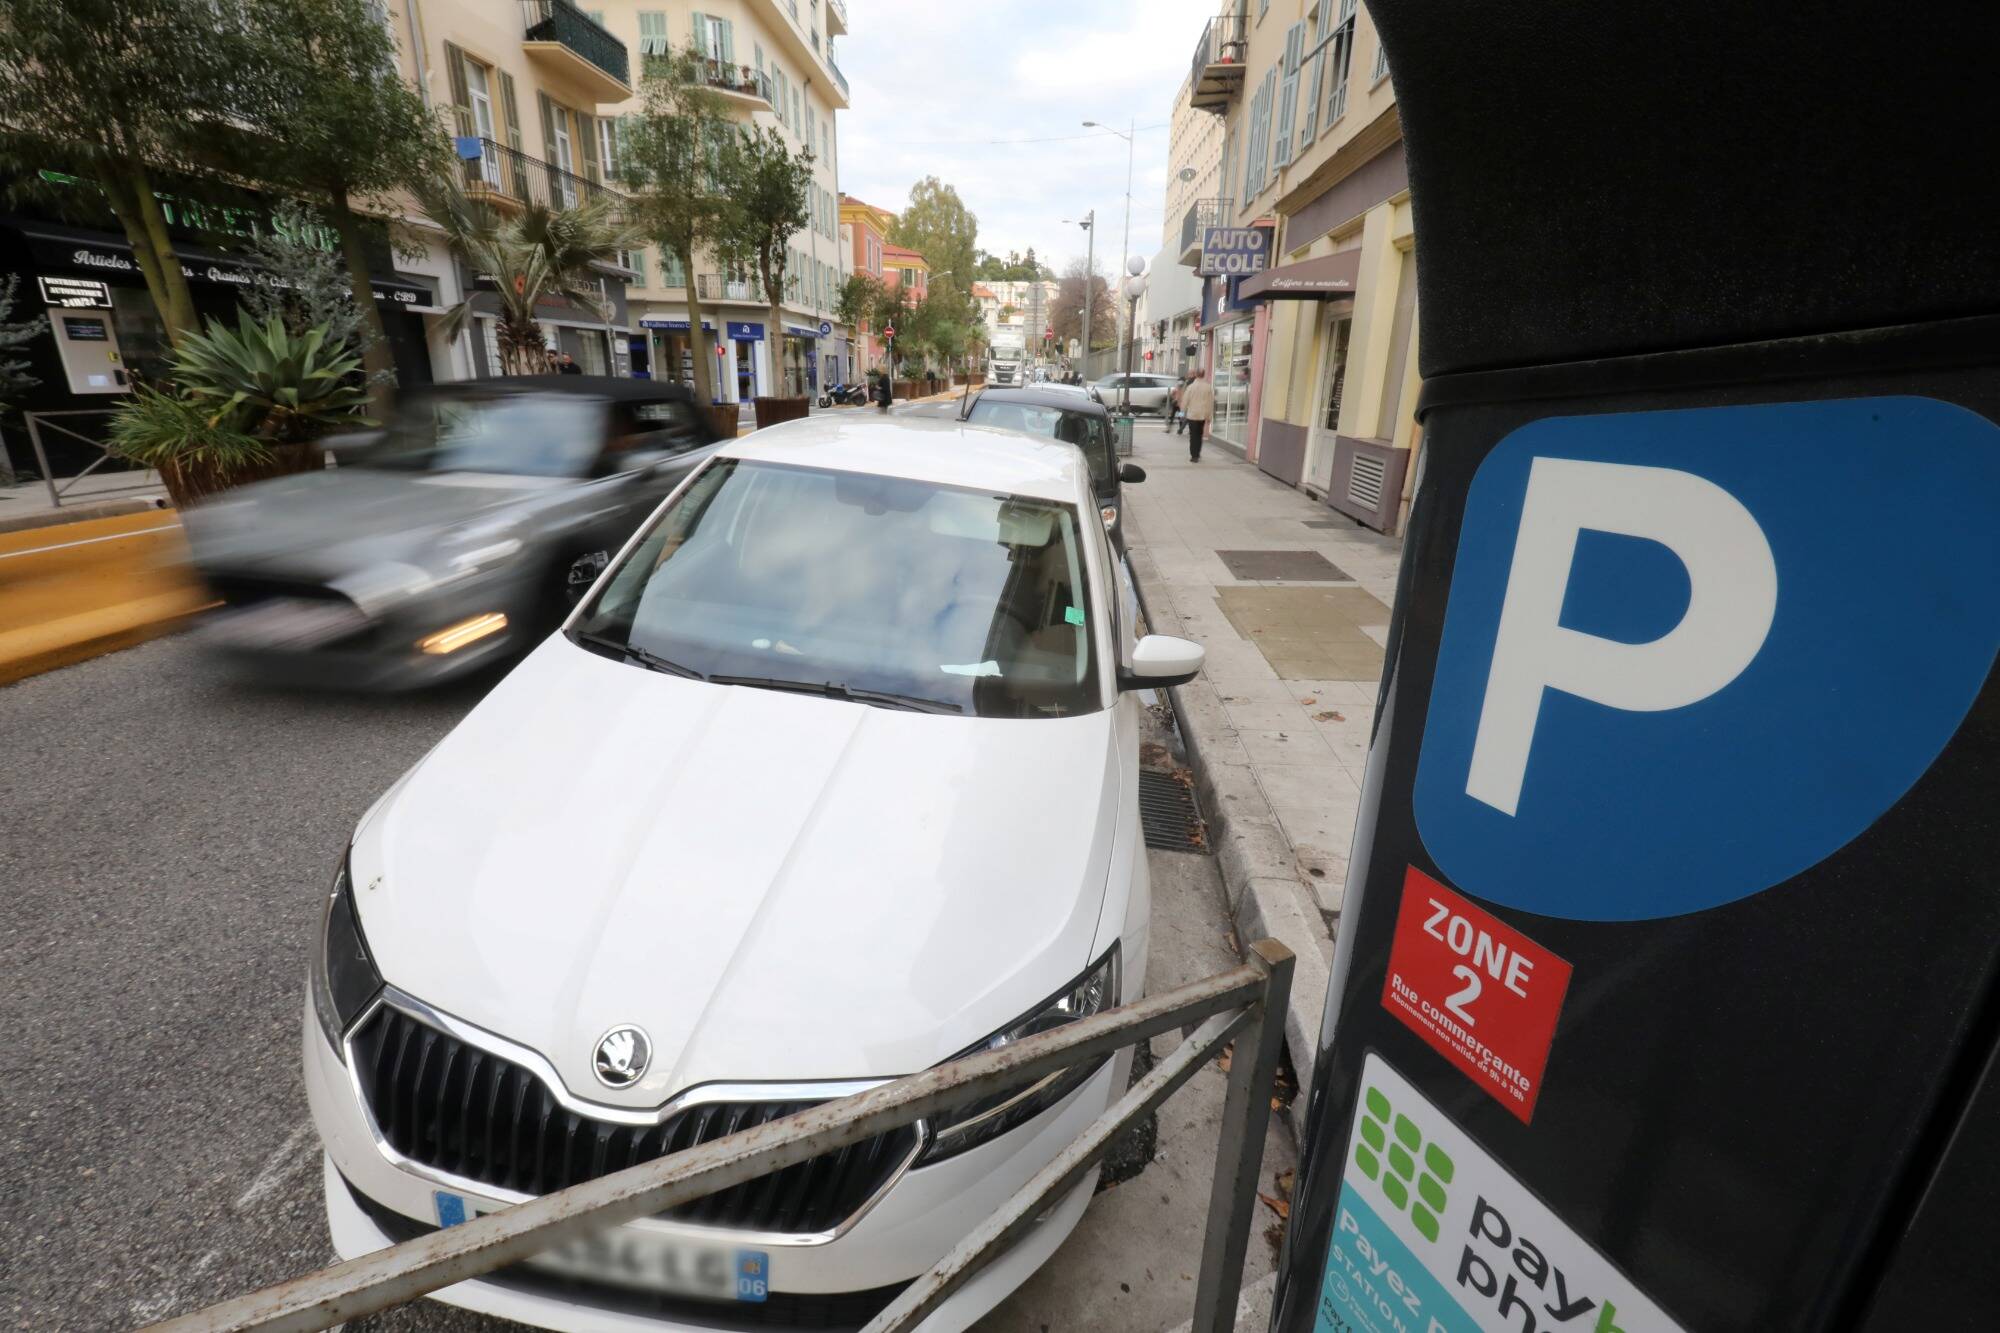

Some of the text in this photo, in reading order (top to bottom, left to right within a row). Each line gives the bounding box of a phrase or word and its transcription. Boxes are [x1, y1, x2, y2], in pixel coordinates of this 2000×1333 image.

[72, 249, 132, 270] Articles
[1203, 253, 1264, 273] ECOLE
[1208, 230, 1263, 250] AUTO
[1465, 456, 1778, 818] P
[1423, 897, 1534, 999] ZONE
[1392, 973, 1531, 1092] Rue commerçante
[1444, 964, 1482, 1028] 2
[1391, 991, 1525, 1102] Abonnement non valide de 9h à 18h
[739, 1279, 767, 1297] 06
[1340, 1208, 1421, 1318] Payez
